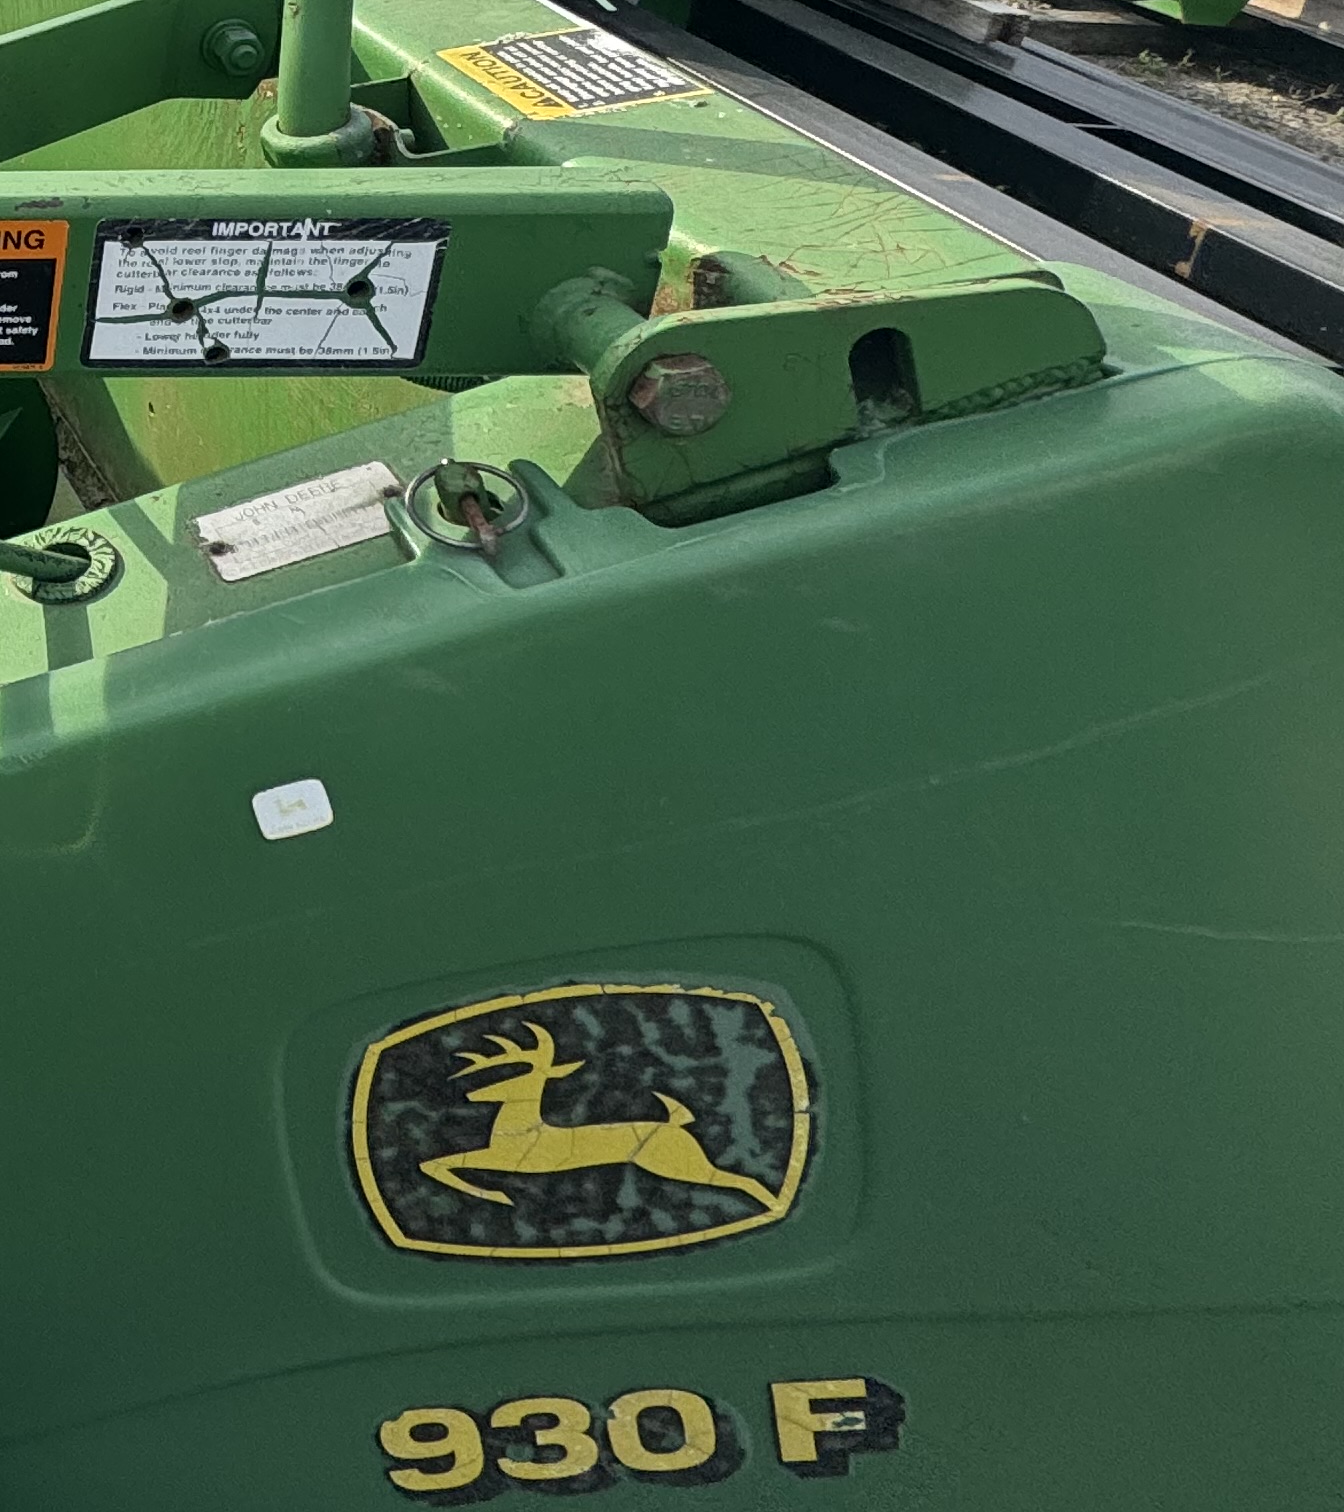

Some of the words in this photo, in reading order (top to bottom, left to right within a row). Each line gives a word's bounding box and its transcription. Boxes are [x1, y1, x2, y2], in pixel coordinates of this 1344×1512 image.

[460, 51, 545, 99] CAUTION
[212, 221, 334, 238] IMPORTANT
[182, 246, 206, 256] reel
[211, 246, 249, 257] finger
[310, 246, 345, 256] when
[172, 258, 207, 267] lower
[308, 257, 329, 266] the
[181, 268, 241, 277] clearance
[112, 302, 138, 311] Flex
[264, 306, 282, 315] the
[285, 307, 323, 316] center
[325, 307, 349, 316] and
[5, 326, 39, 336] safety
[144, 332, 181, 343] Lower
[233, 330, 261, 341] fully
[142, 346, 197, 356] Minimum
[265, 346, 295, 356] must
[298, 346, 314, 355] be
[234, 500, 278, 522] JOHN
[379, 1388, 717, 1491] 930
[770, 1378, 868, 1463] F
